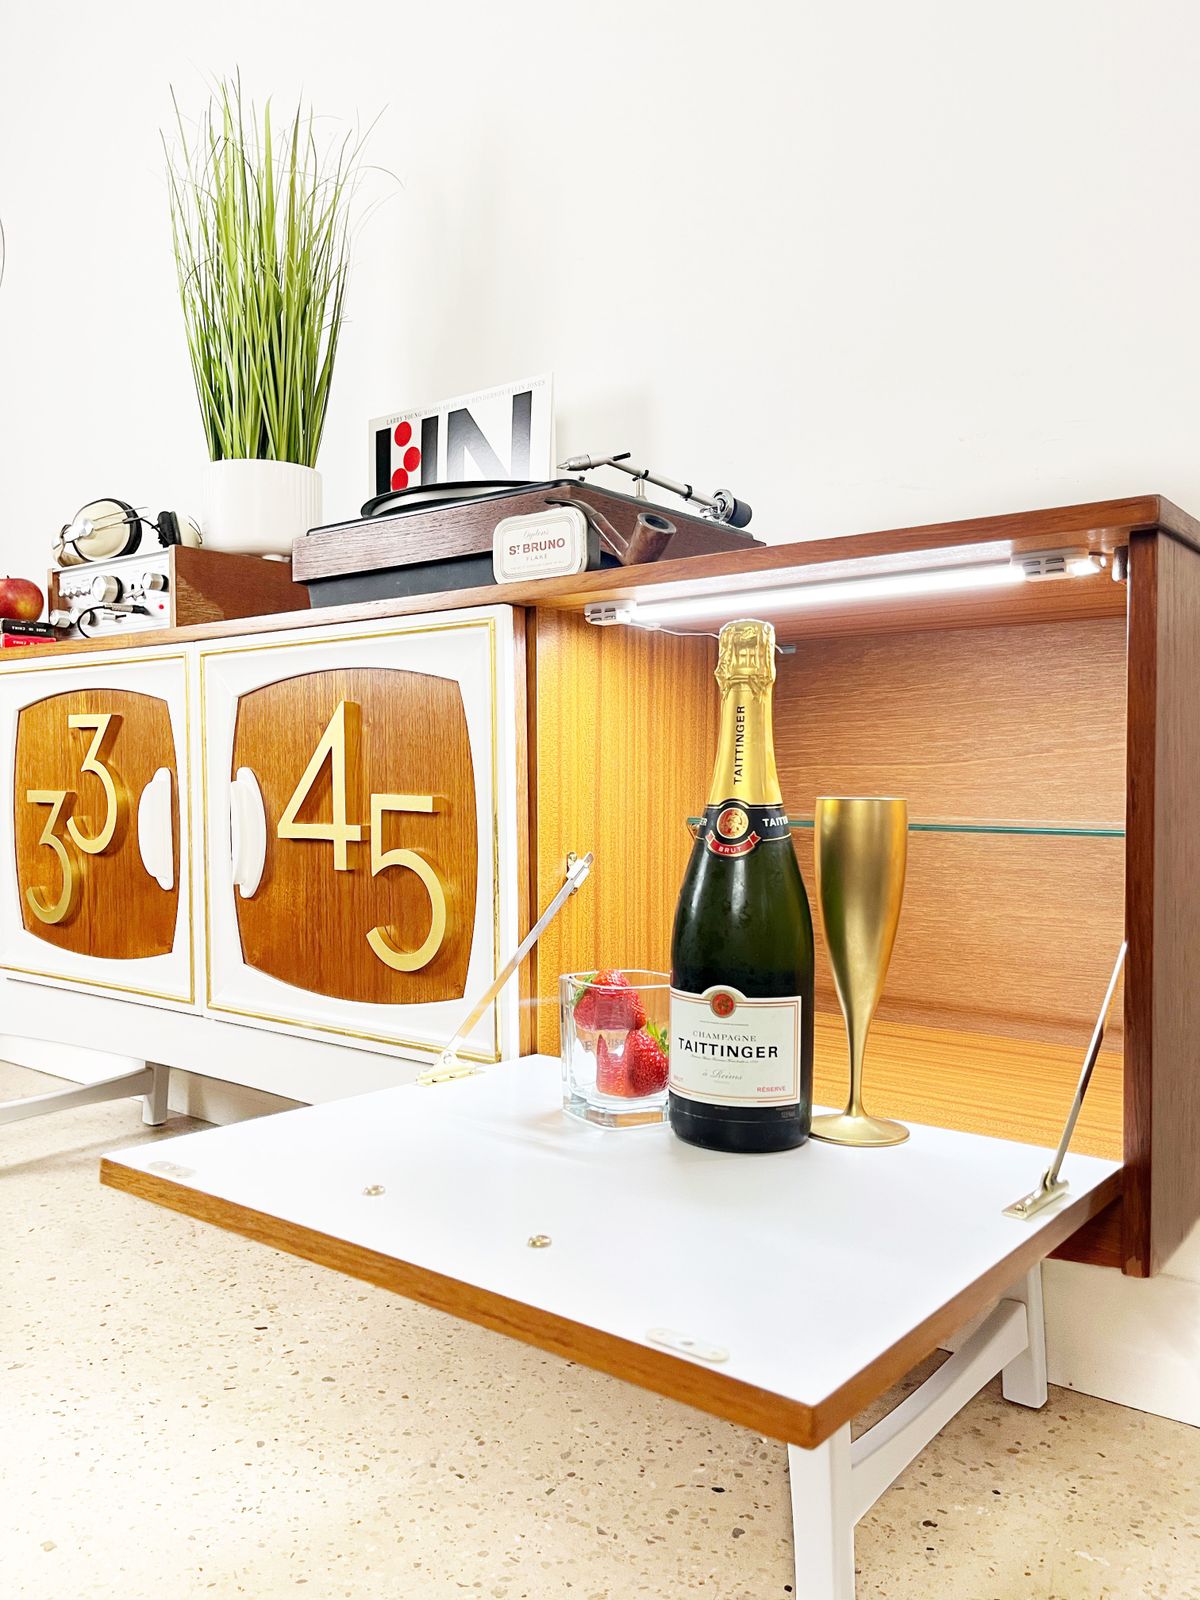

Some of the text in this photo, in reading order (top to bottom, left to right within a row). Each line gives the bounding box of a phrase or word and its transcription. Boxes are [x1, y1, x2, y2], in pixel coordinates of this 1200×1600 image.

[522, 537, 566, 554] BRUNO
[733, 705, 746, 785] TAITTINGER
[718, 845, 742, 854] BRUT
[692, 1030, 757, 1042] CHAMPAGNE
[678, 1037, 779, 1059] TAITTINGER
